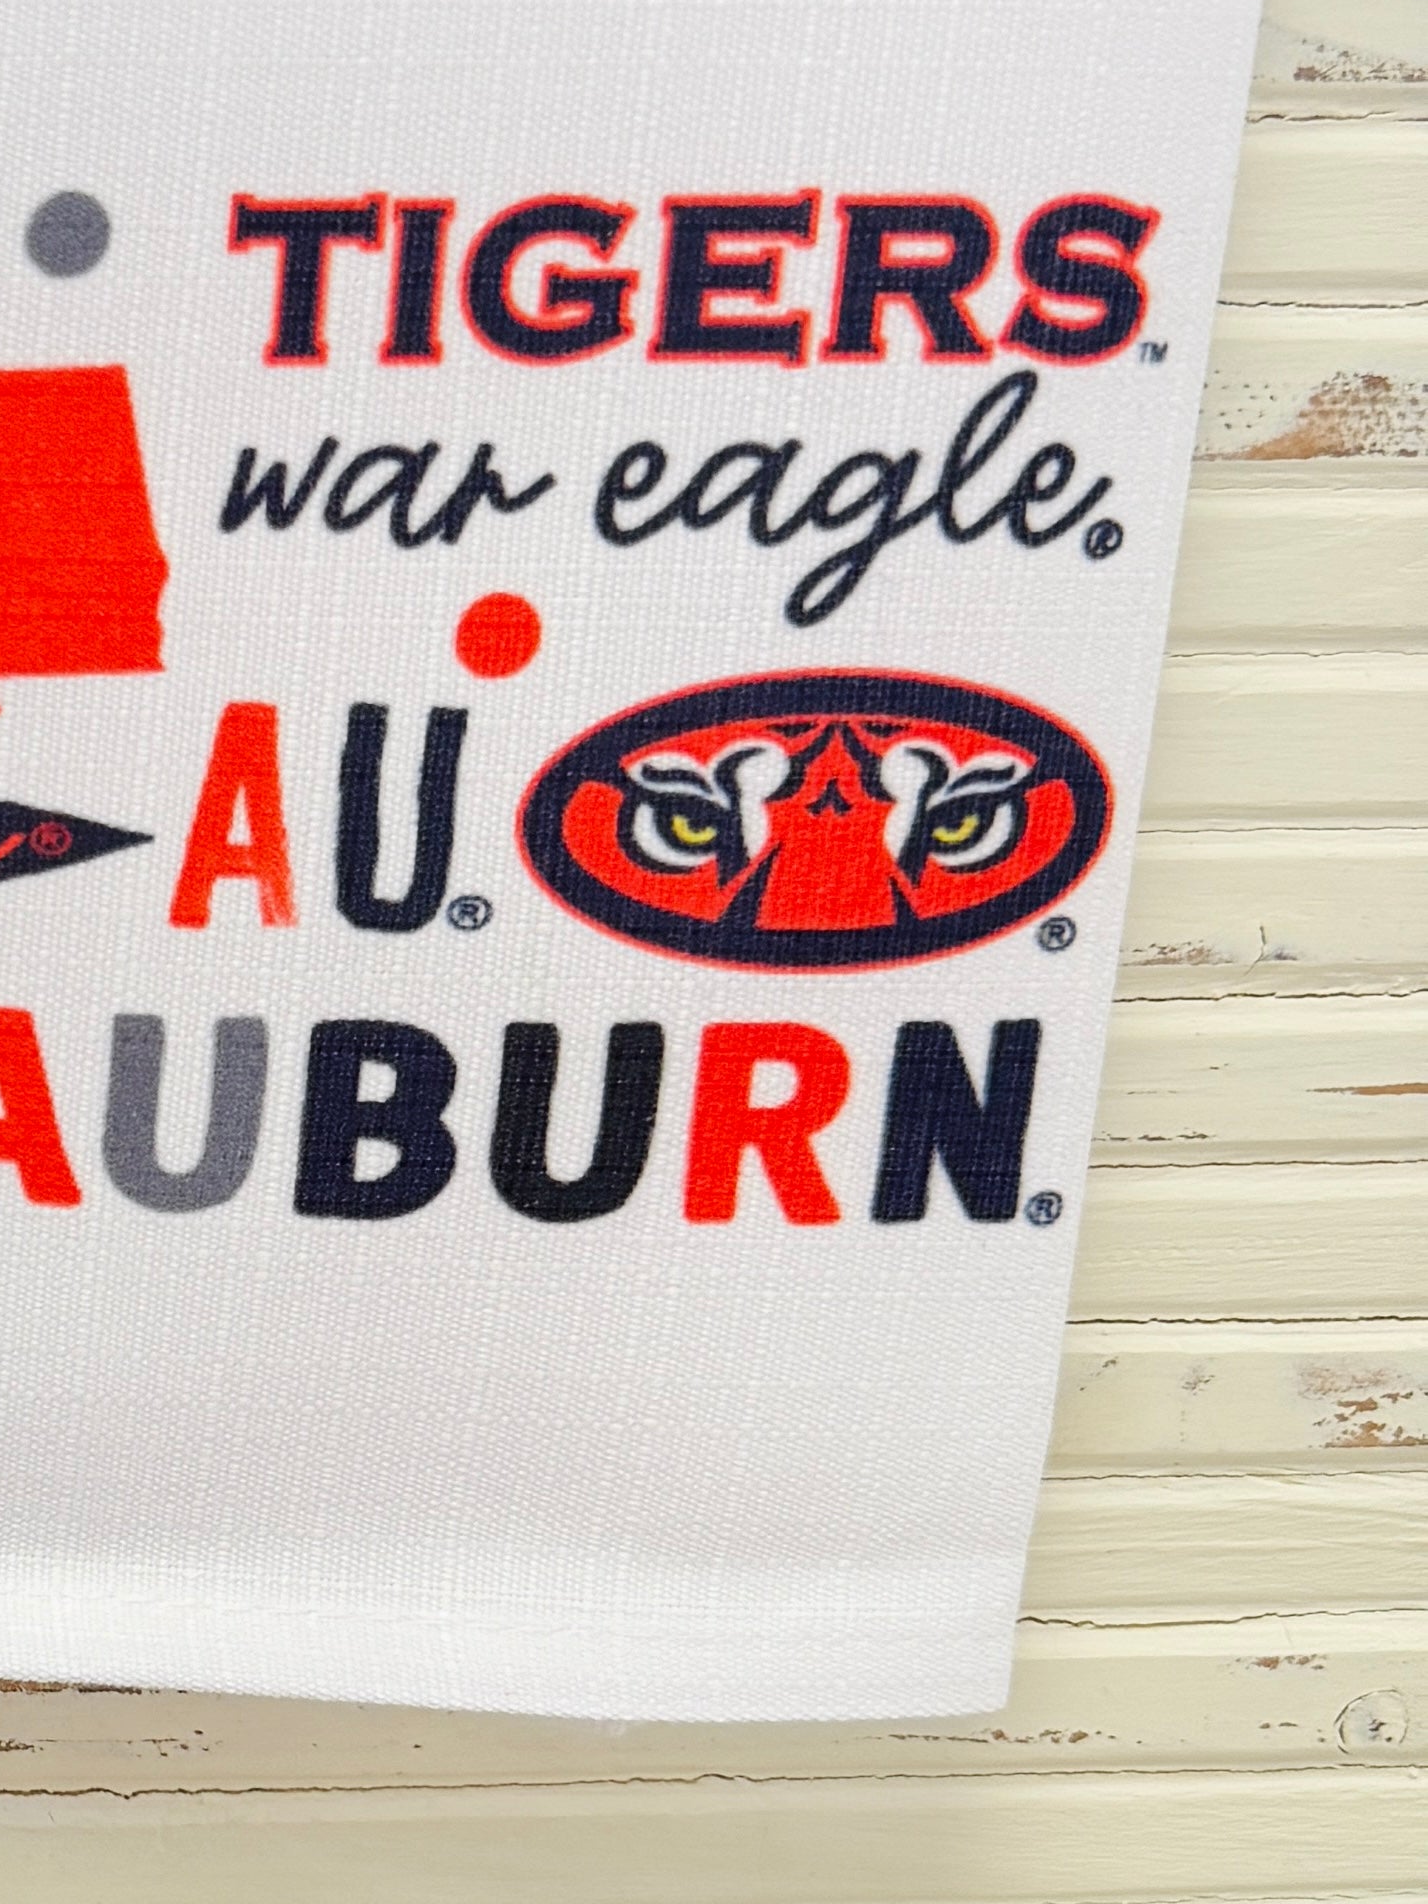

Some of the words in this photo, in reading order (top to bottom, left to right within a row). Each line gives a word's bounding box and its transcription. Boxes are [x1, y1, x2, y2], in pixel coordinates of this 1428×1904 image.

[227, 188, 1164, 369] TIGERS
[220, 436, 556, 550] war
[595, 370, 1112, 629] eagle
[170, 702, 468, 935] AU
